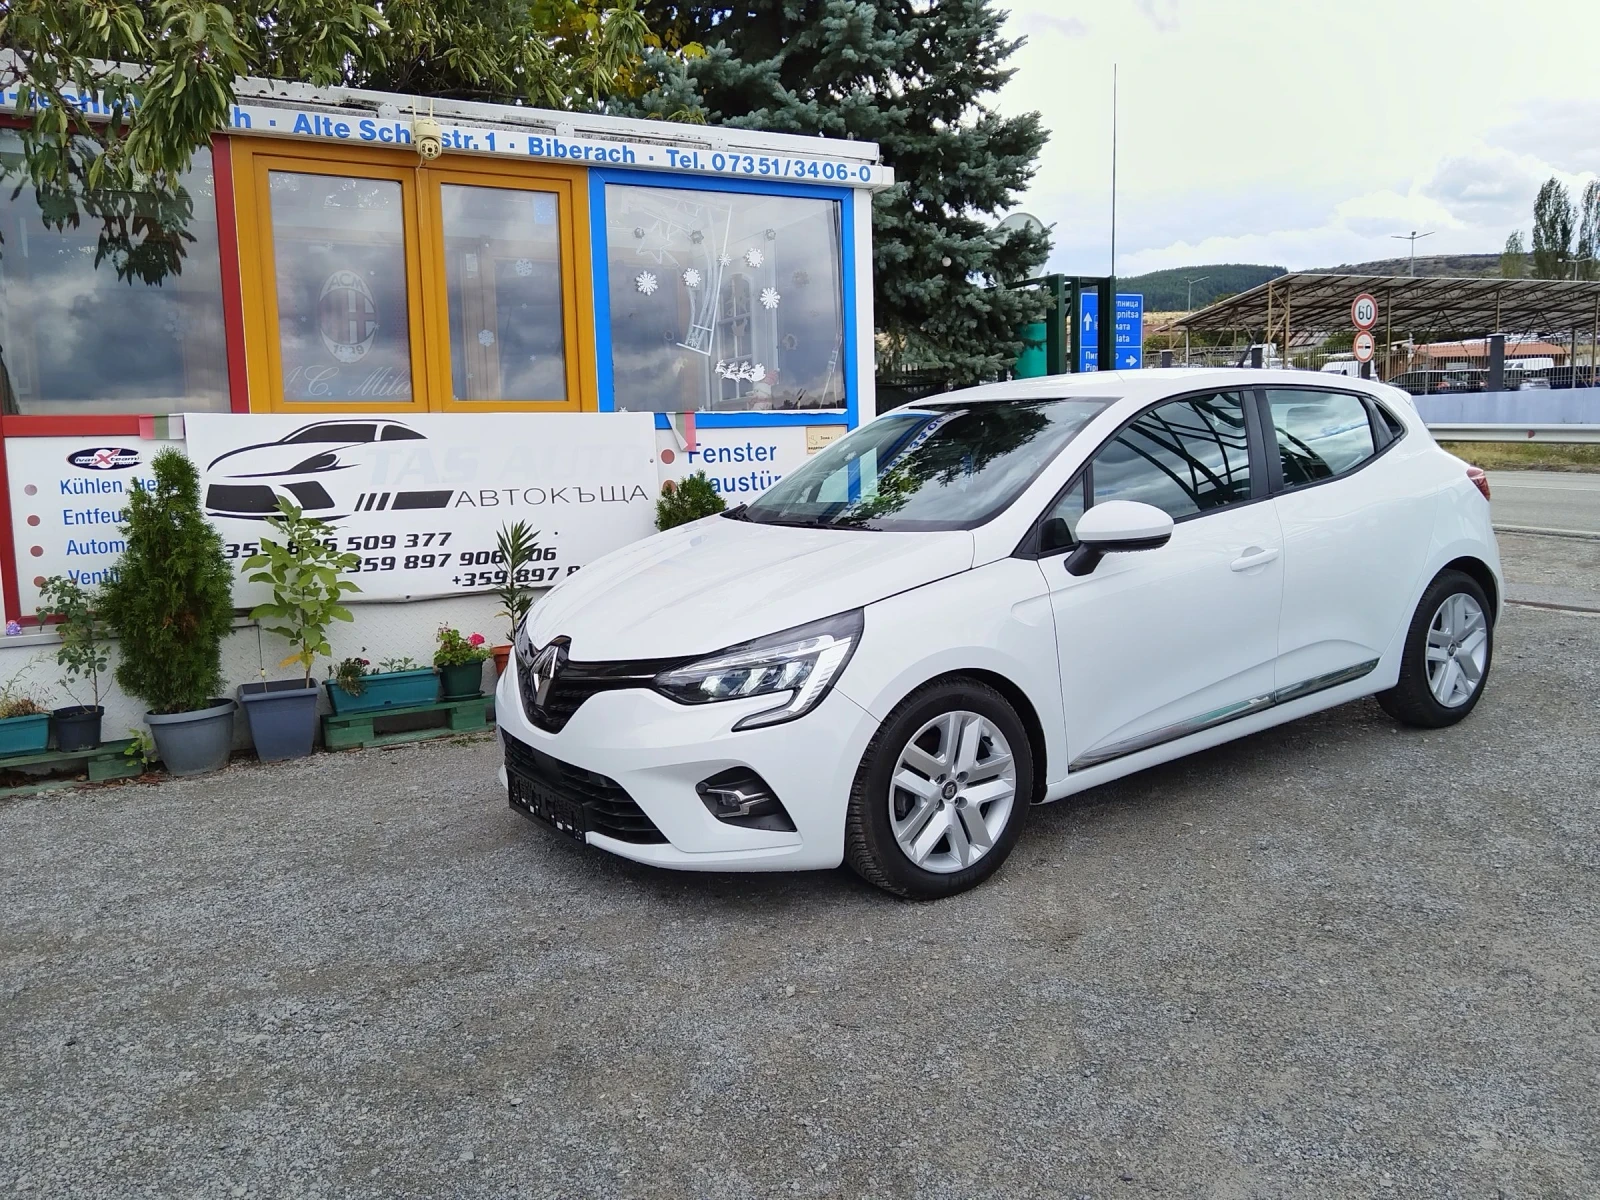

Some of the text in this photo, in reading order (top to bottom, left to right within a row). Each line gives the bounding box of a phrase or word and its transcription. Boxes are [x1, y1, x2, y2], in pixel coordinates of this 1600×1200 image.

[293, 113, 350, 138] Alte
[359, 119, 479, 150] Schstr.
[528, 136, 635, 164] Biberach
[666, 149, 705, 170] Tel.
[711, 152, 872, 183] 07351/3406-0
[1116, 300, 1139, 309] пница
[1358, 304, 1373, 320] 60
[1116, 309, 1139, 320] pnitsa
[1116, 333, 1130, 342] lata
[454, 484, 649, 508] АВТОКЪЩА
[346, 535, 397, 551] 509
[404, 532, 452, 548] 377
[403, 553, 452, 570] 897
[452, 570, 508, 587] +359
[515, 567, 560, 583] 897
